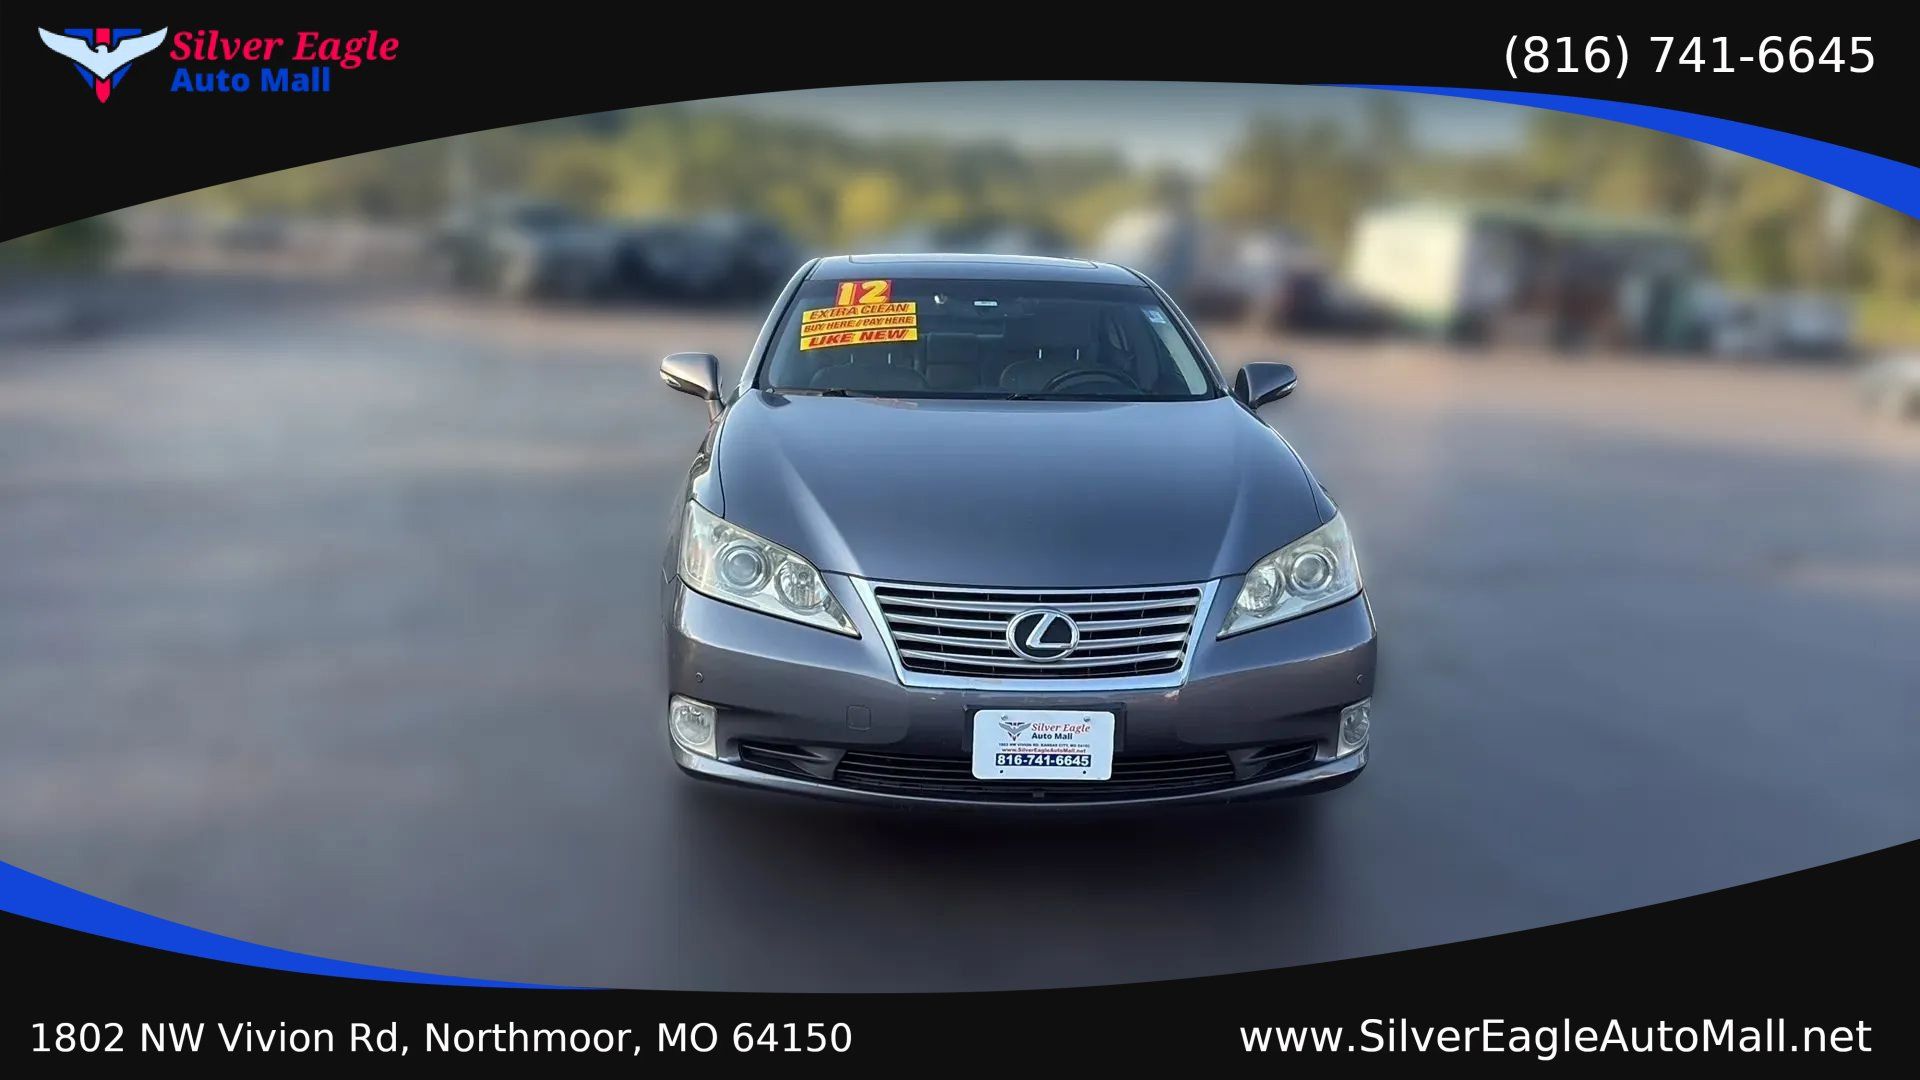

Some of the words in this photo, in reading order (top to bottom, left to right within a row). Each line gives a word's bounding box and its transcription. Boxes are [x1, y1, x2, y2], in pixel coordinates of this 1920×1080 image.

[837, 280, 888, 306] 12
[809, 305, 858, 320] EXTRA
[860, 303, 909, 315] CLEAN
[804, 322, 825, 333] BUY
[826, 319, 854, 331] HERE
[884, 315, 913, 325] HERE
[809, 332, 854, 347] LIKE
[859, 329, 909, 342] NEW
[1032, 722, 1061, 732] Silver
[1063, 724, 1090, 734] Eagle
[1032, 732, 1052, 740] Auto
[1054, 733, 1073, 741] Mall
[997, 754, 1090, 766] 816-741-6645
